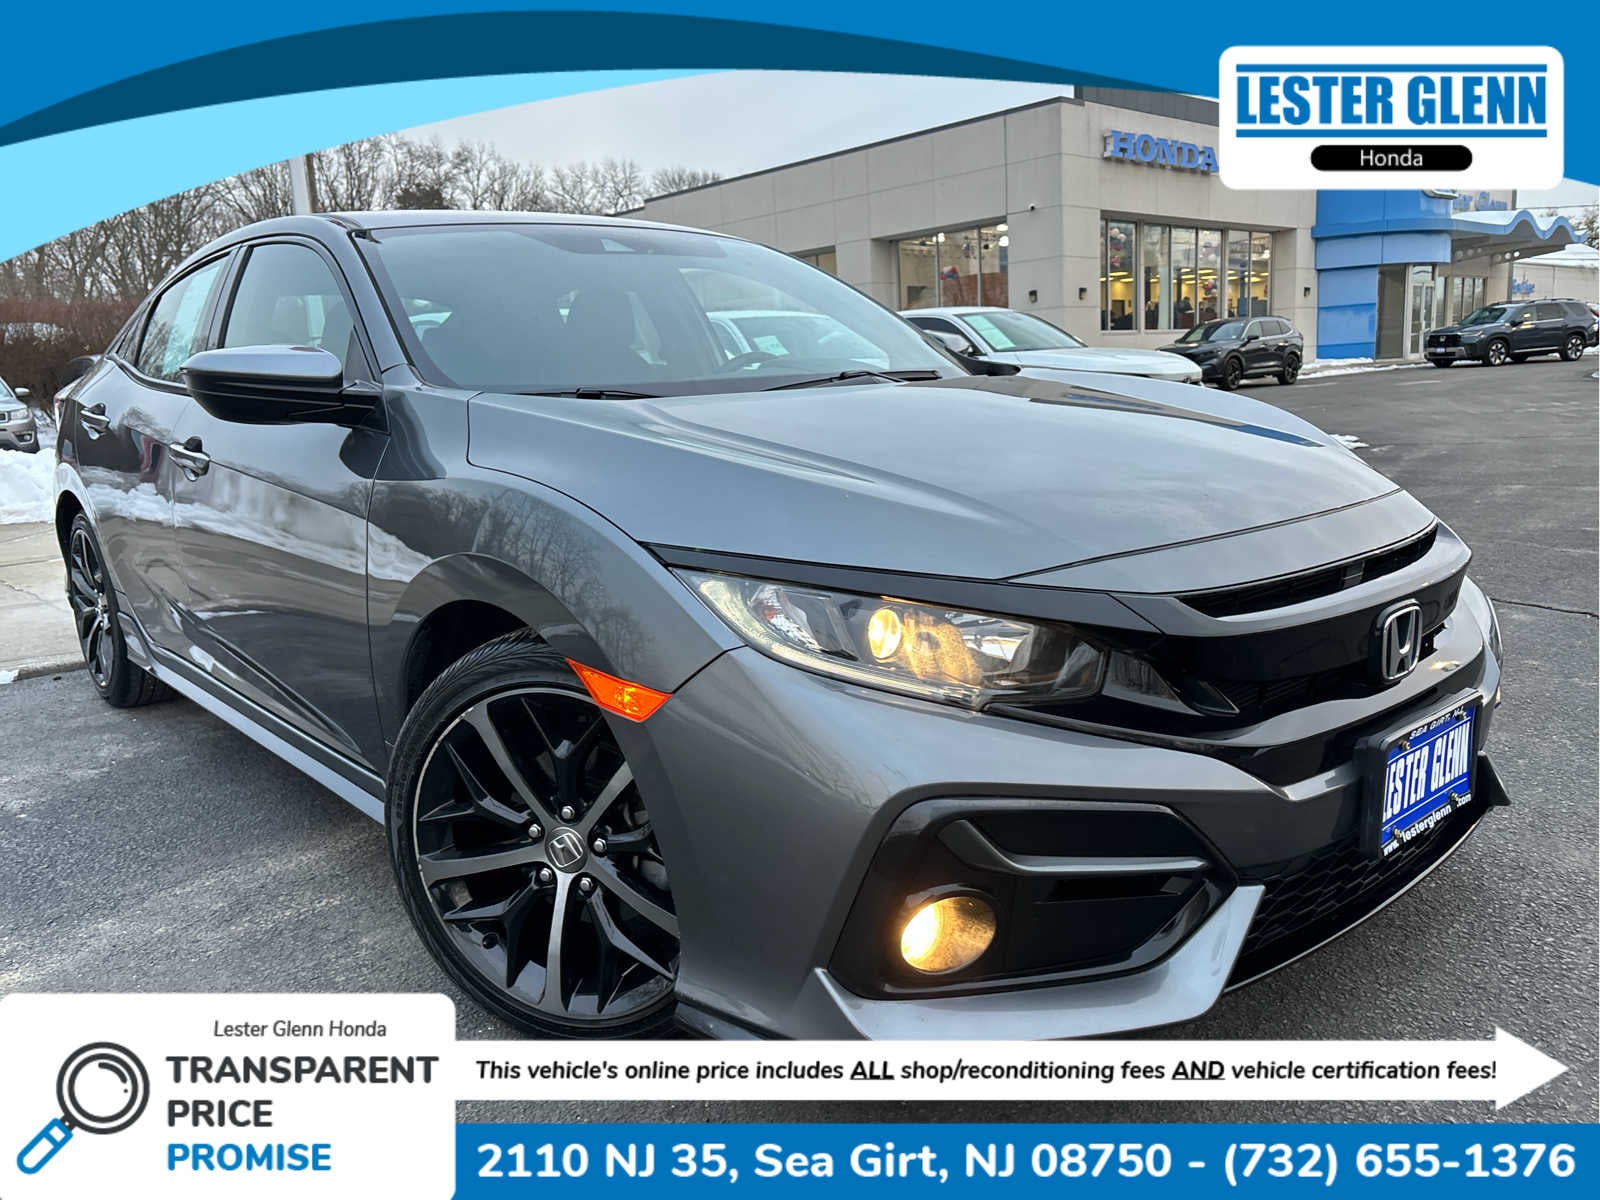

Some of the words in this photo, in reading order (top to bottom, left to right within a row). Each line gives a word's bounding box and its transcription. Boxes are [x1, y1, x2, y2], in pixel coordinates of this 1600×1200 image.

[1110, 130, 1219, 173] HONDA
[1409, 725, 1428, 739] SEA
[1430, 721, 1471, 792] GLENN
